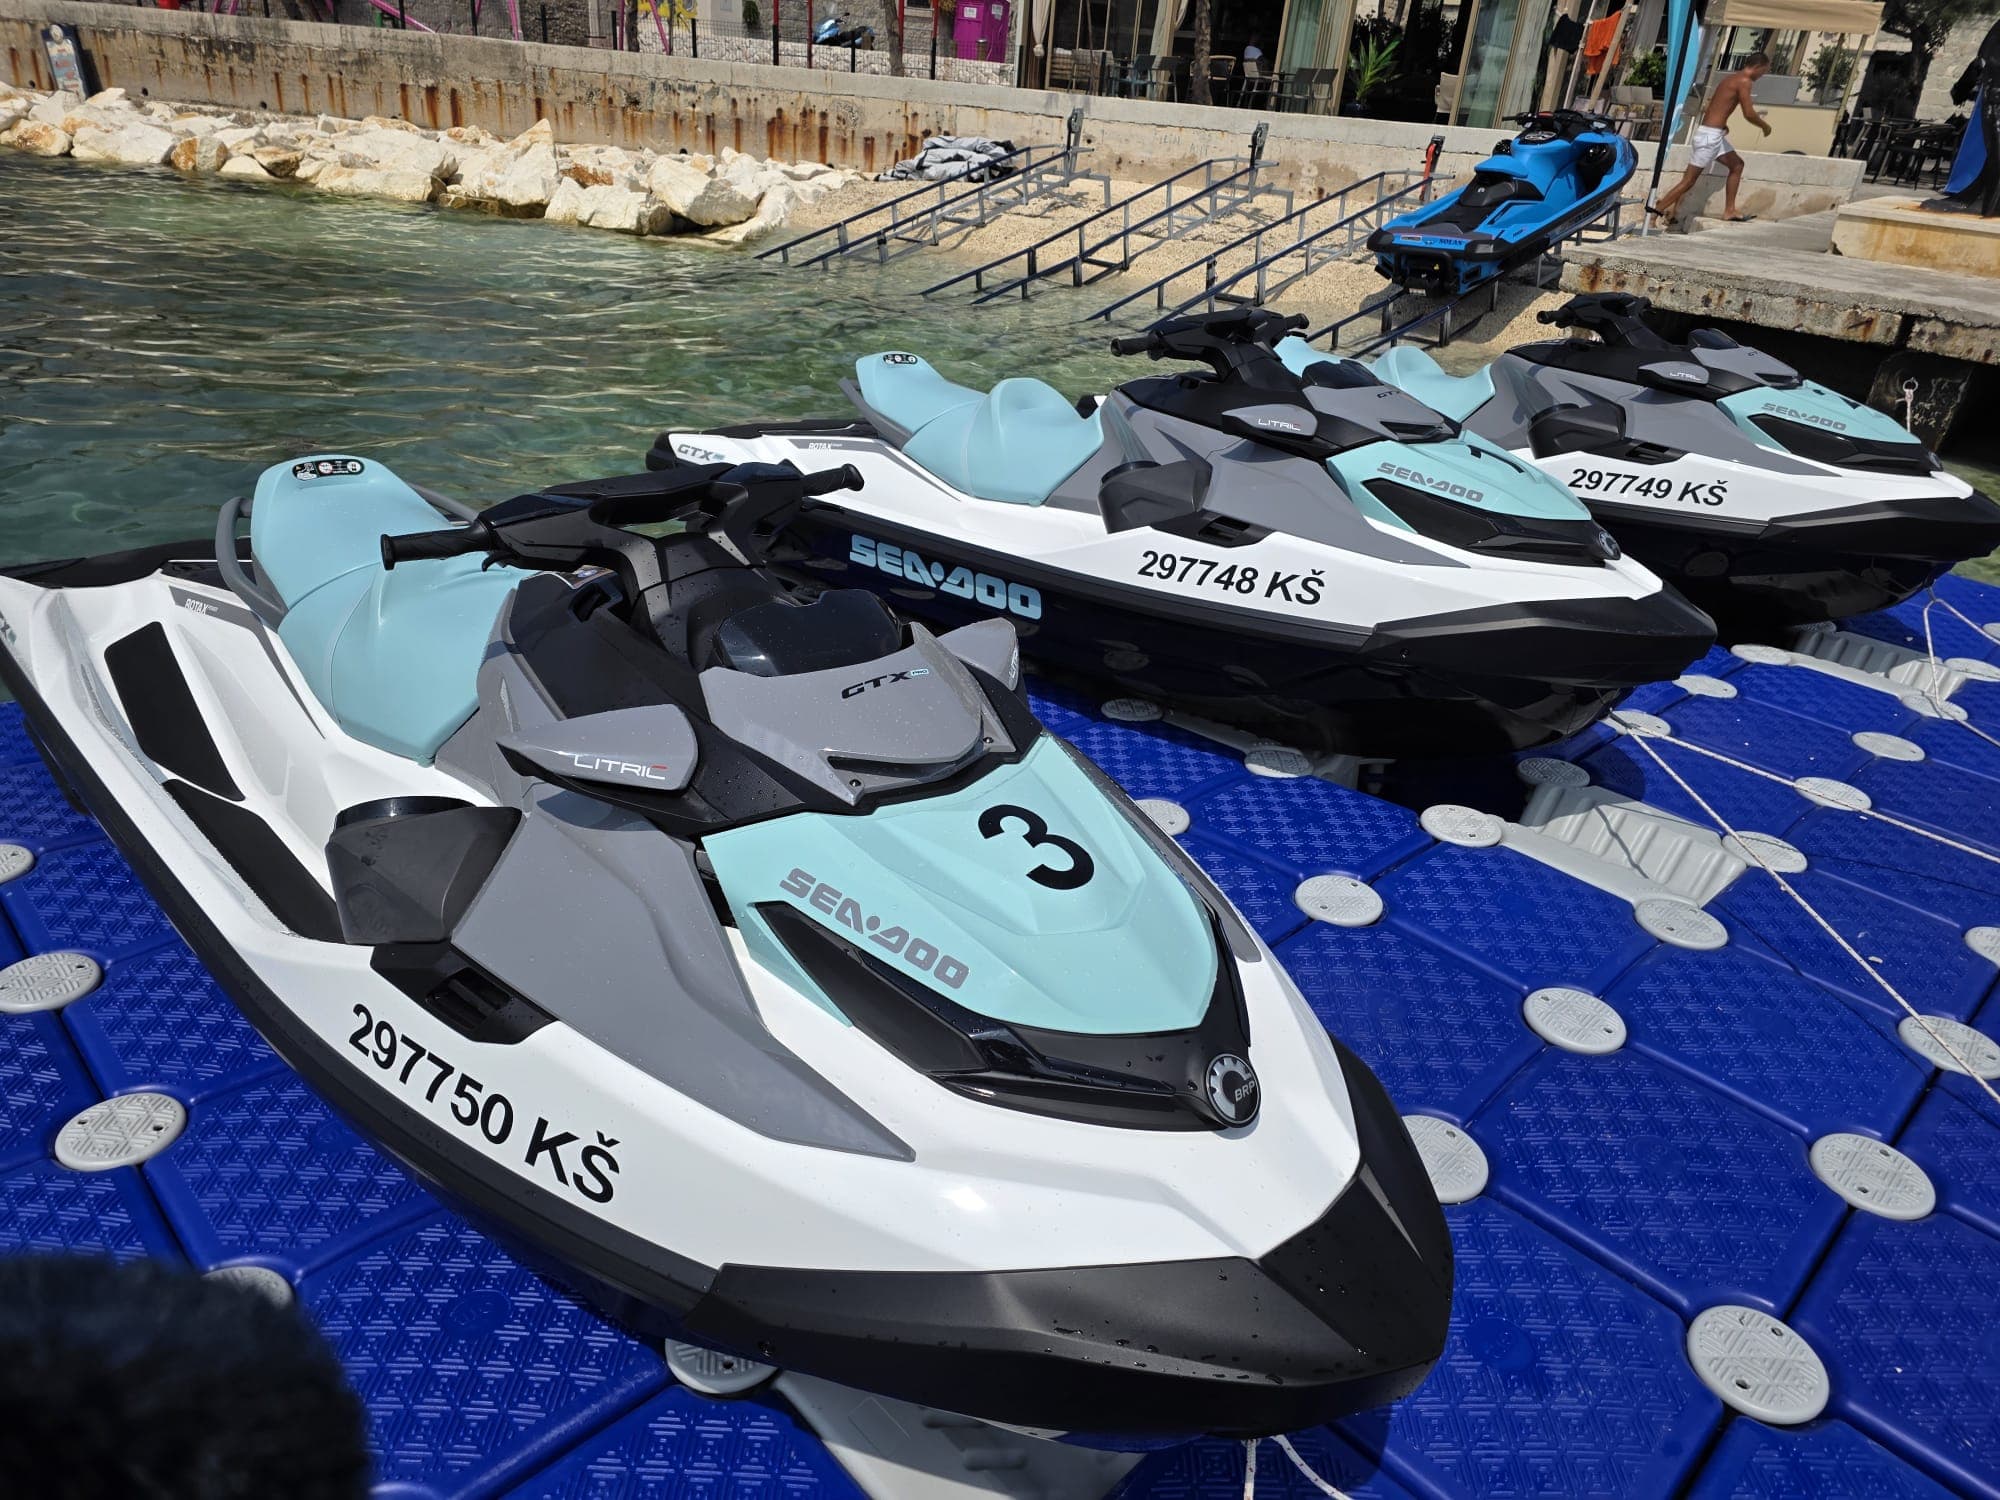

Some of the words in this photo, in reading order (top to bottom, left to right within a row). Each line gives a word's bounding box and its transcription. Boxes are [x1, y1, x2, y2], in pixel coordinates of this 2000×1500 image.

[677, 443, 714, 461] GTX
[1568, 468, 1673, 499] 297749
[1677, 479, 1728, 506] KŠ
[1137, 550, 1259, 594] 297748
[1264, 568, 1326, 605] KŠ
[841, 671, 912, 699] GTX
[574, 754, 668, 780] LITRIC
[978, 803, 1095, 891] 3
[348, 1003, 514, 1145] 297750
[524, 1116, 621, 1203] KŠ
[1234, 1080, 1255, 1103] BRP
